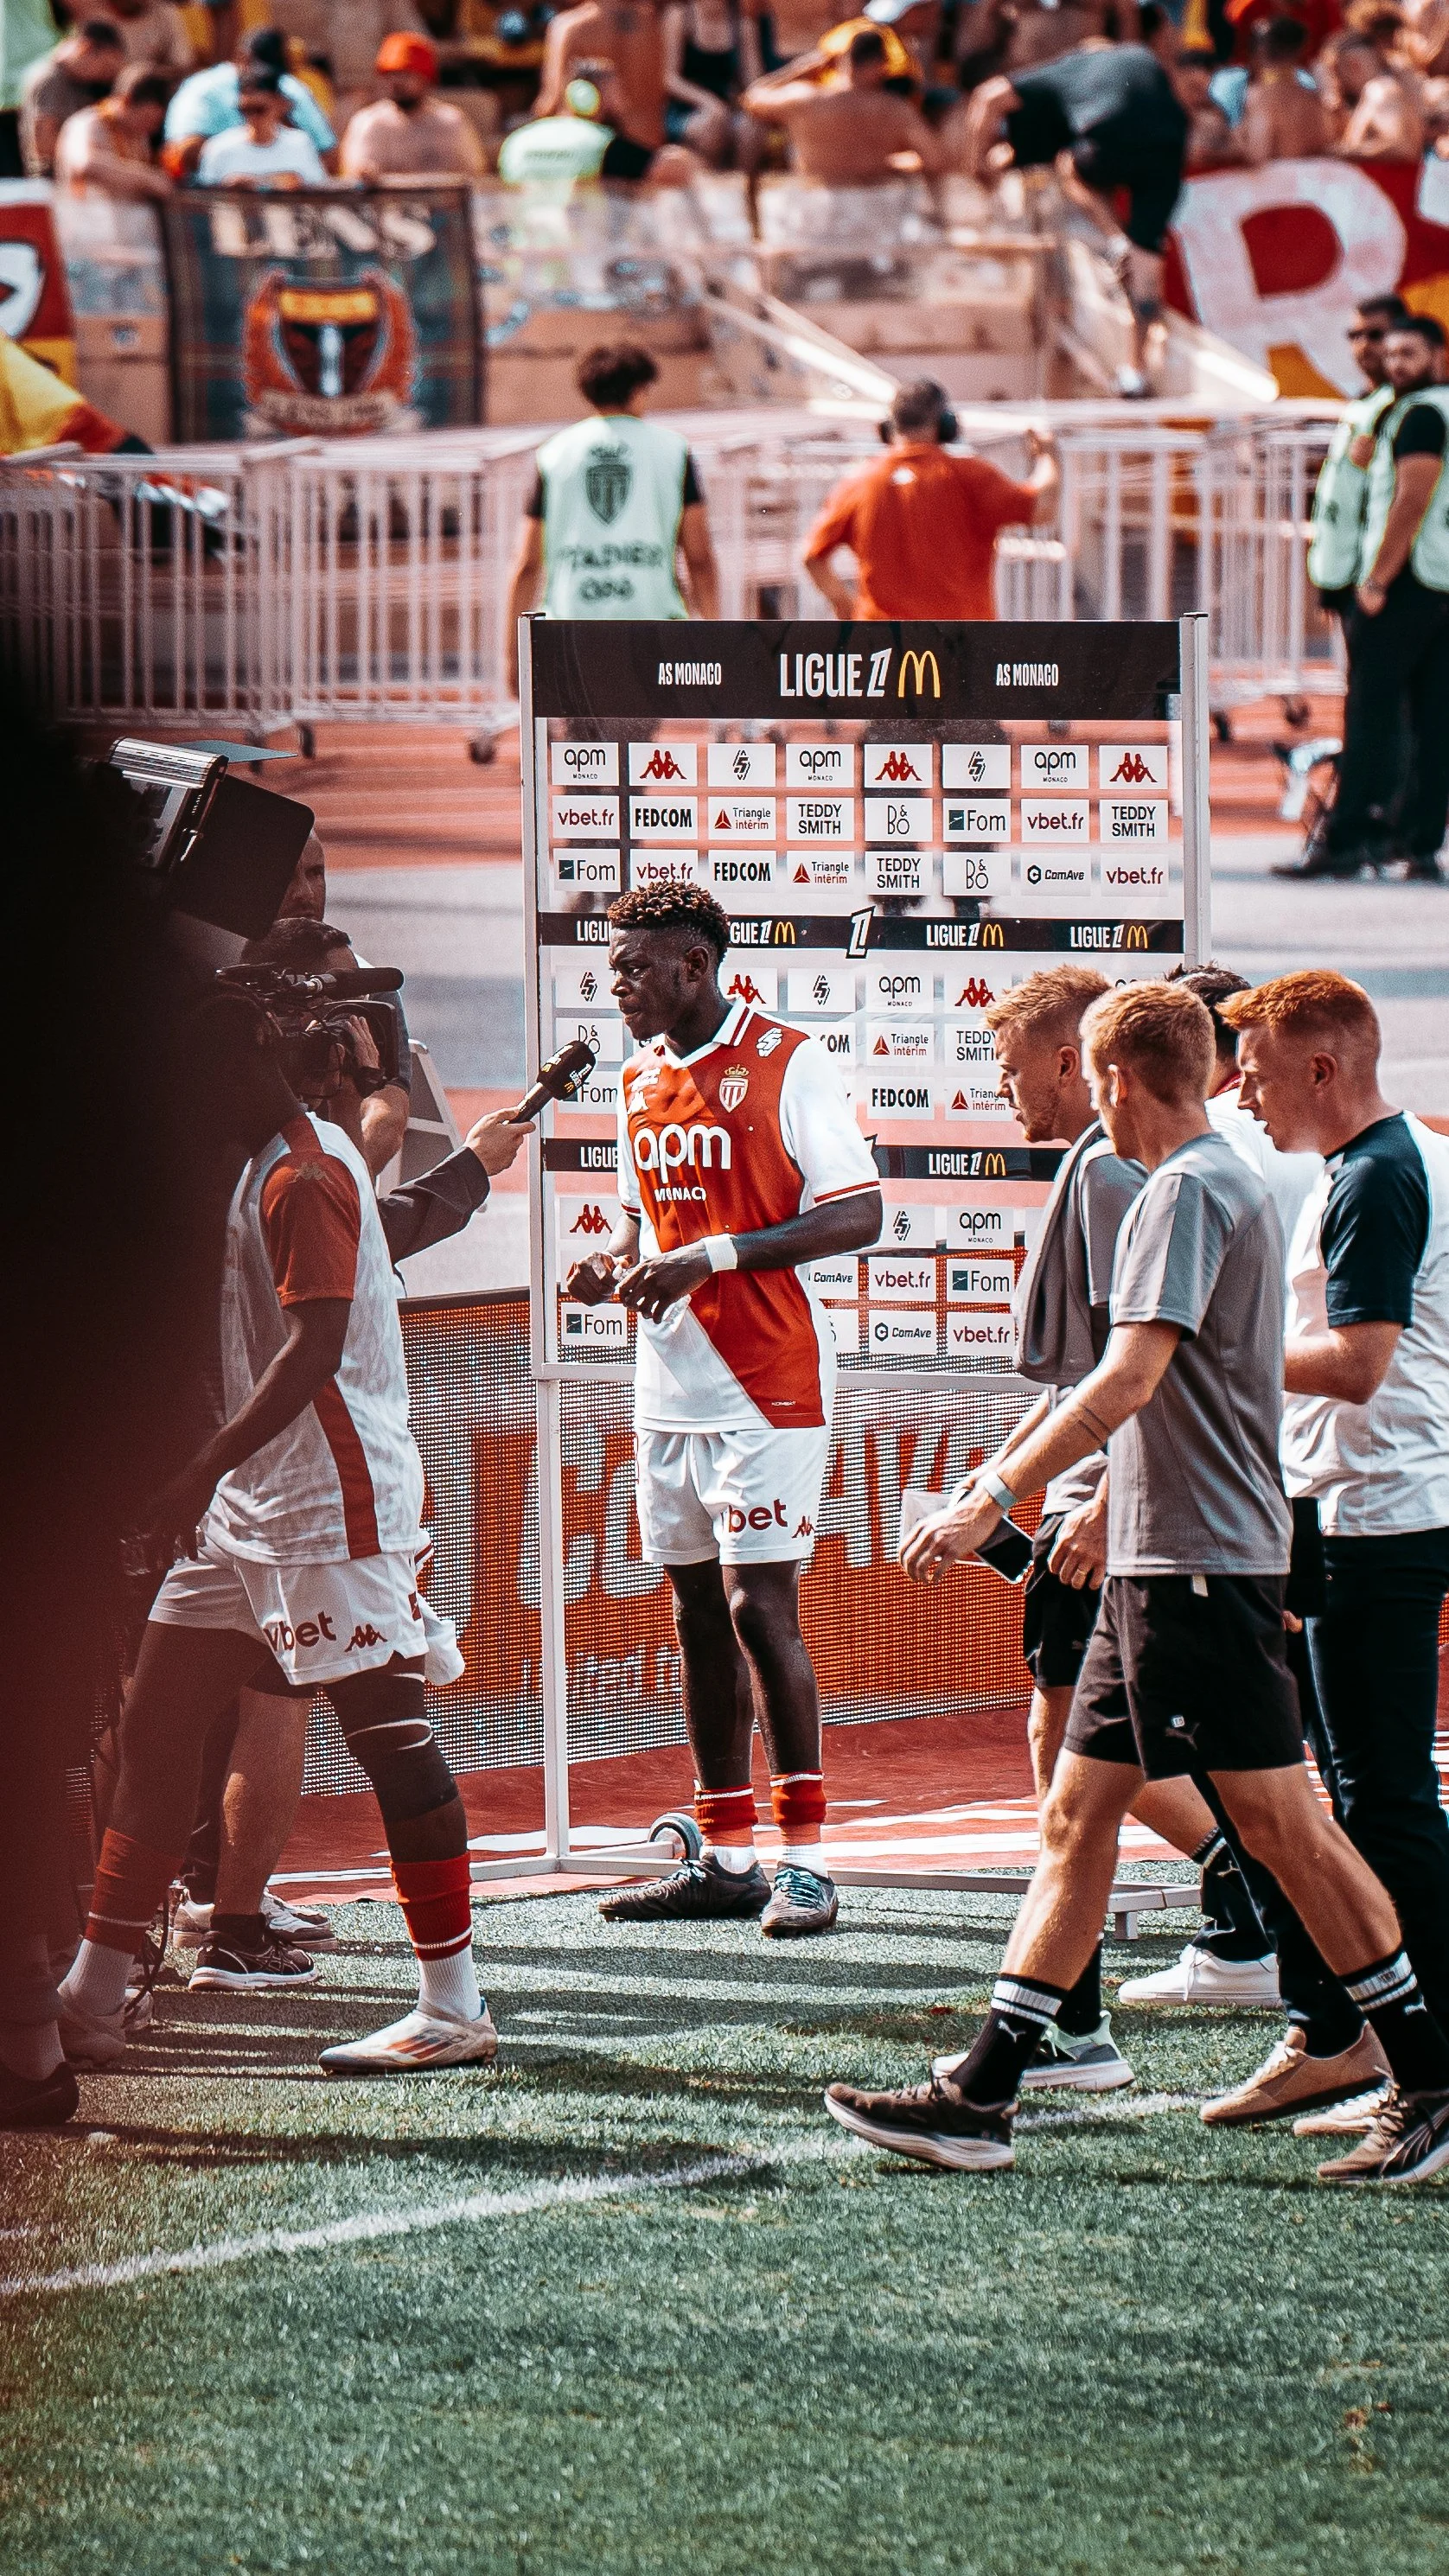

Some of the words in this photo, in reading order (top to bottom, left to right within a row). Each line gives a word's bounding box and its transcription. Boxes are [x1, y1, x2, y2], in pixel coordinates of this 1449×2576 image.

[208, 201, 437, 261] LENS
[659, 663, 673, 685] AS
[675, 663, 721, 685] MONACO
[996, 663, 1011, 686] AS
[1013, 663, 1058, 686] MONACO
[564, 749, 606, 773] apm
[799, 749, 841, 774] apm
[1035, 751, 1076, 775] apm
[557, 808, 615, 826] vbet.fr
[635, 807, 693, 828] FEDCOM
[732, 807, 771, 819] Triangle
[798, 803, 842, 818] TEDDY
[1112, 806, 1156, 820] TEDDY
[735, 818, 769, 830] intérim
[798, 819, 841, 835] SMITH
[967, 809, 1006, 832] Fom
[1027, 812, 1084, 830] vbet.fr
[1111, 822, 1155, 838] SMITH
[577, 859, 616, 881] Fom
[636, 863, 693, 879] vbet.fr
[713, 862, 771, 882] FEDCOM
[811, 860, 850, 874] Triangle
[877, 858, 921, 872] TEDDY
[814, 871, 848, 884] intérim
[877, 874, 921, 889] SMITH
[1044, 869, 1085, 881] ComAve
[1107, 866, 1163, 884] vbet.fr
[878, 975, 921, 999] apm
[890, 1033, 929, 1047] Triangle
[893, 1043, 927, 1056] intérim
[871, 1087, 929, 1108] FEDCOM
[970, 1087, 1000, 1101] Triang
[972, 1100, 1006, 1111] intérim
[634, 1123, 731, 1184] apm
[959, 1212, 1001, 1236] apm
[813, 1272, 853, 1284] ComAve
[874, 1271, 931, 1289] vbet.fr
[971, 1270, 1010, 1292] Fom
[584, 1313, 622, 1336] Fom
[891, 1327, 932, 1338] ComAve
[953, 1325, 1010, 1343] vbet.fr
[720, 1498, 788, 1533] bet
[263, 1610, 337, 1652] vbet
